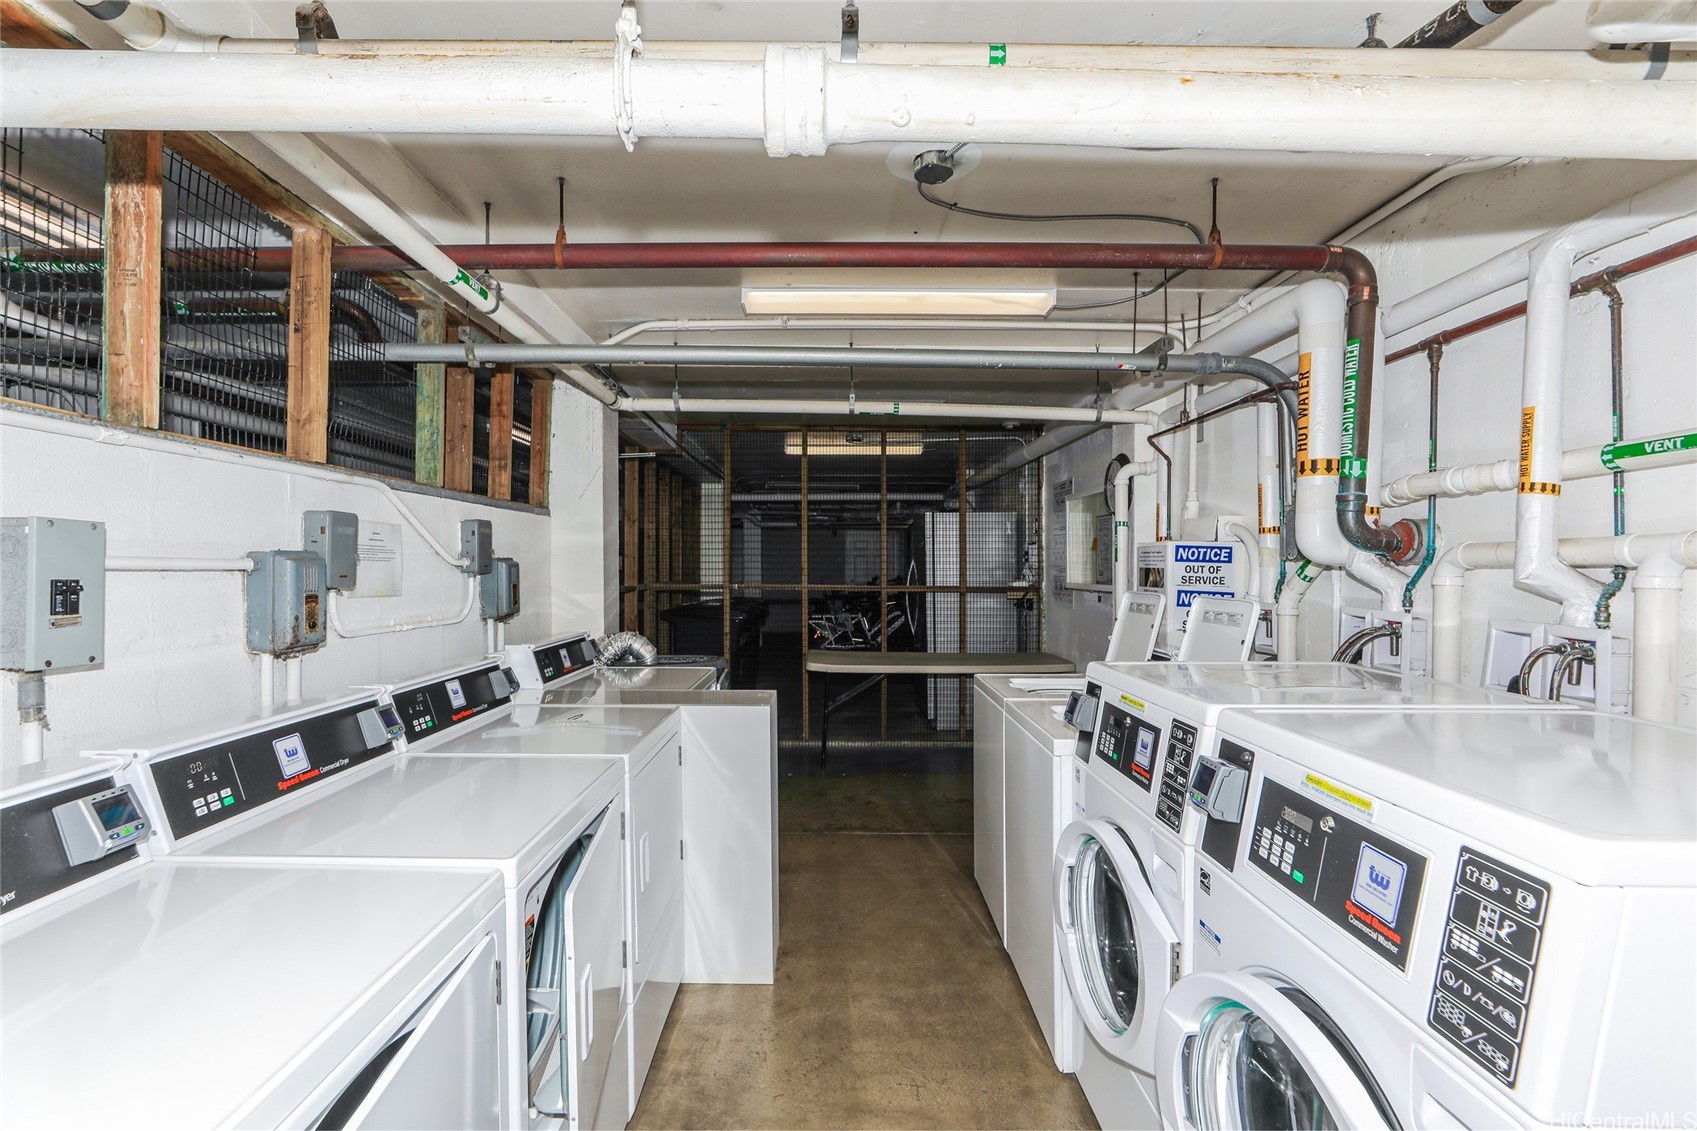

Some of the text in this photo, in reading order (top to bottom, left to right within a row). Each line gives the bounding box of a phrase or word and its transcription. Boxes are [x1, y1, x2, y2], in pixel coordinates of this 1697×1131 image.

[1297, 370, 1310, 452] HOT WATER
[1340, 343, 1360, 457] DOMESTIC COLD WATER
[1520, 412, 1532, 477] HOT WATER SUPPLY
[1644, 436, 1685, 453] VENT
[1177, 547, 1231, 561] NOTICE
[1184, 564, 1222, 575] OUT OF
[1181, 575, 1226, 586] SERVICE
[277, 775, 299, 790] Speed
[298, 768, 320, 781] Queen
[319, 761, 341, 774] Commercial
[340, 757, 350, 766] Dryer
[1345, 900, 1402, 945] Speed Queen
[1348, 914, 1399, 955] Commercial Washer
